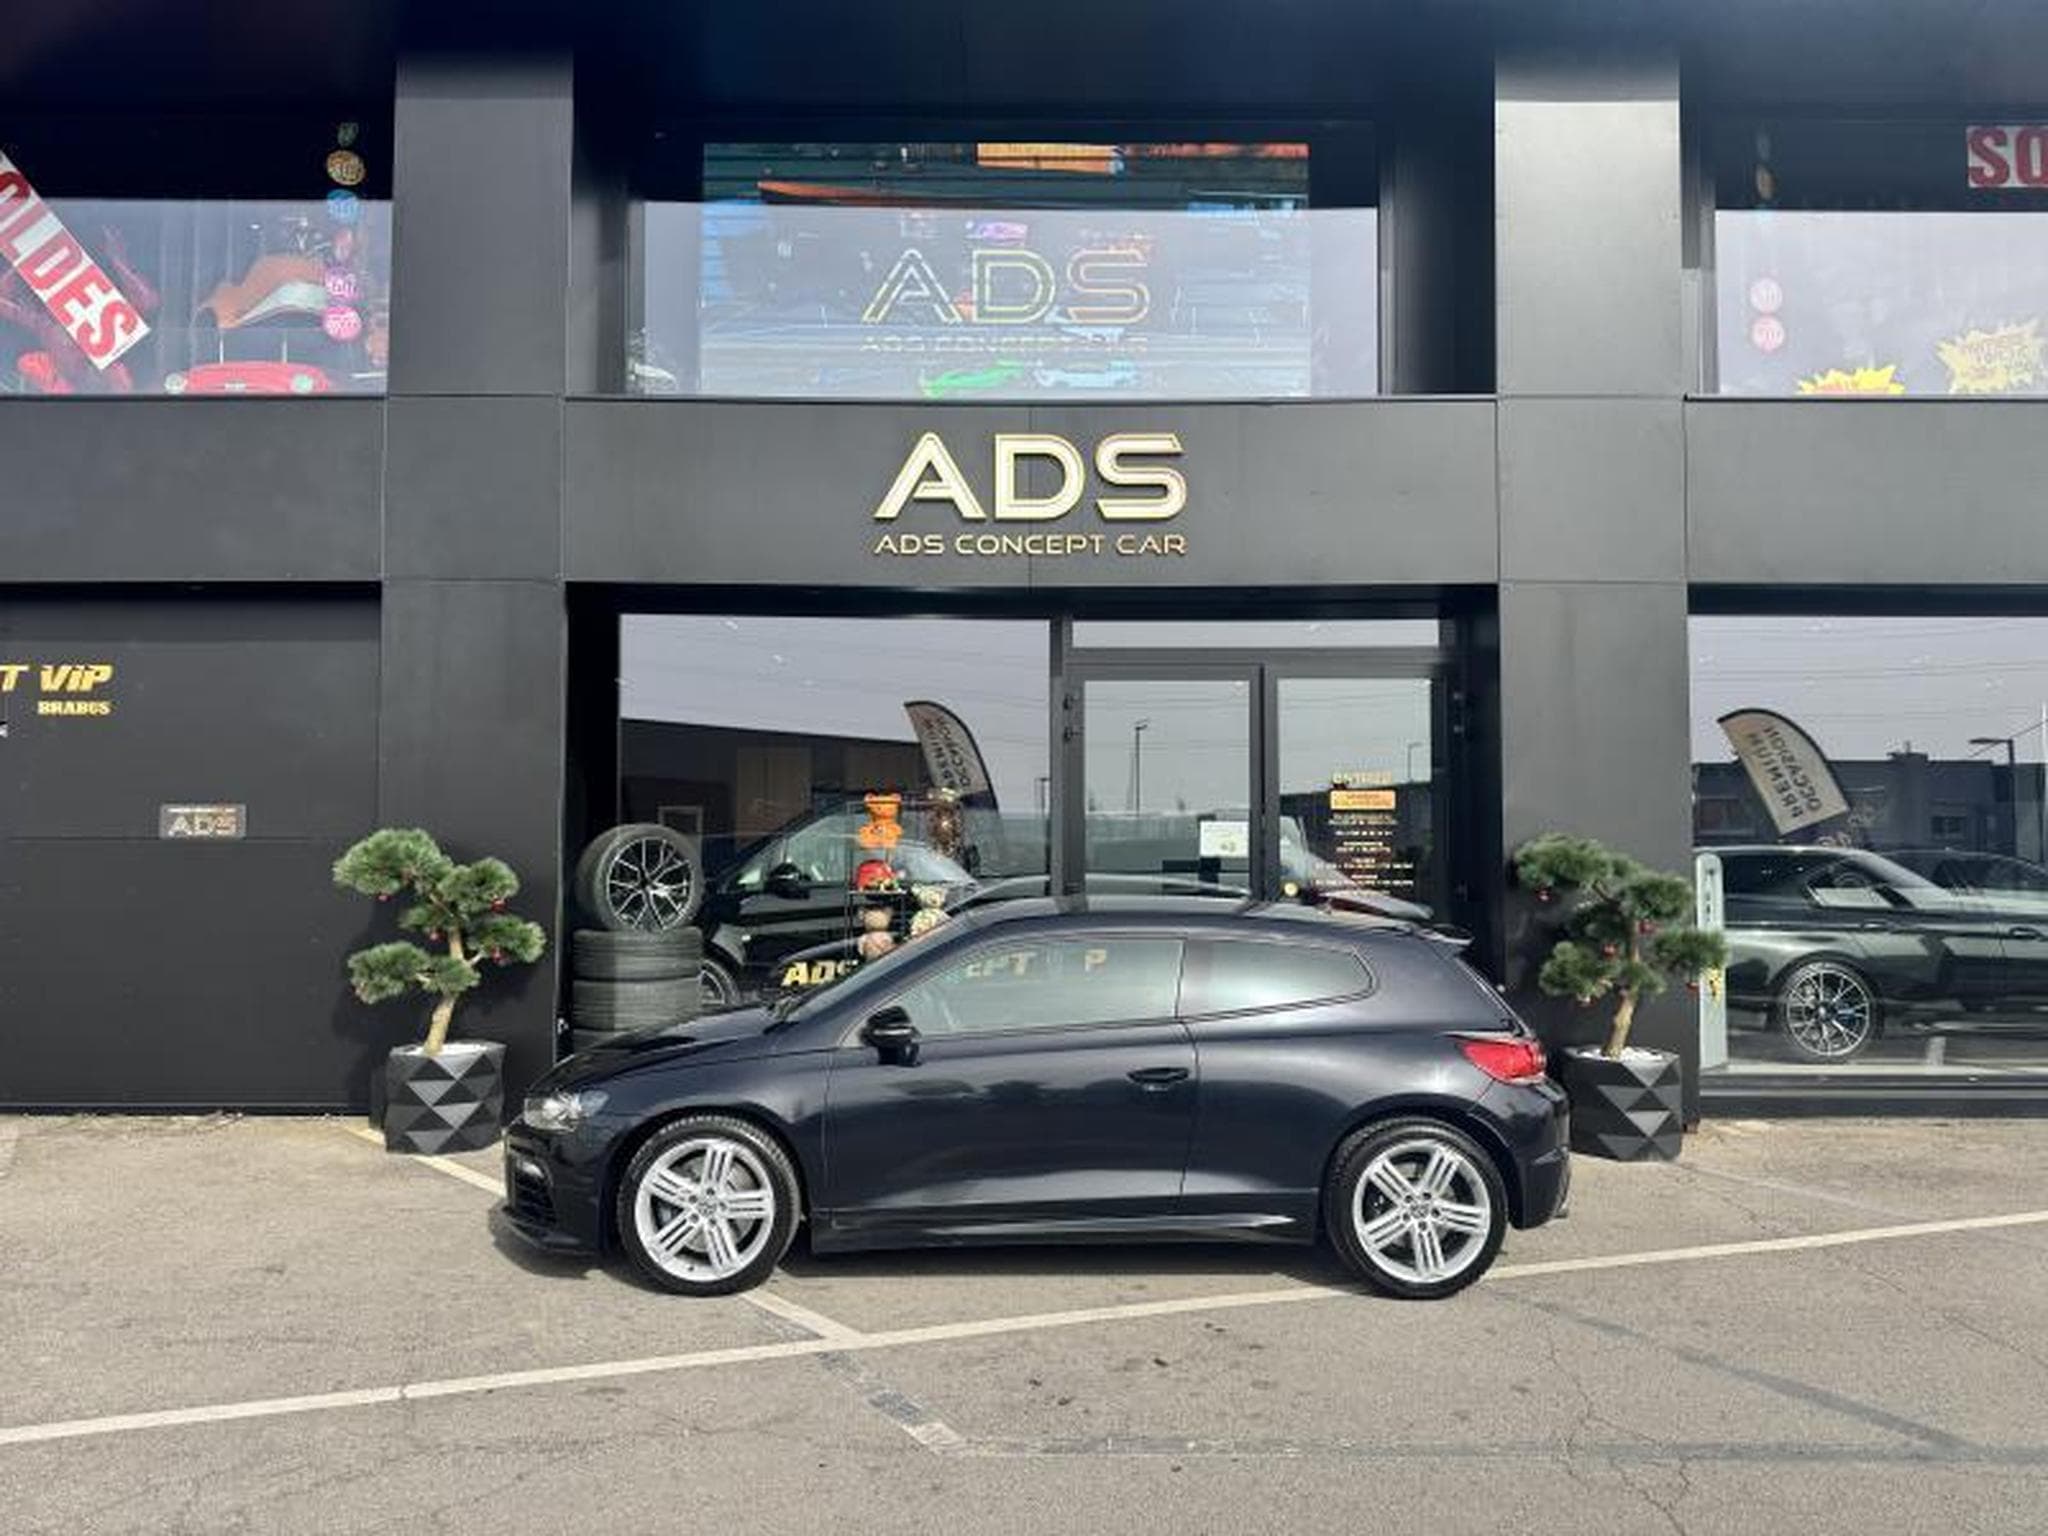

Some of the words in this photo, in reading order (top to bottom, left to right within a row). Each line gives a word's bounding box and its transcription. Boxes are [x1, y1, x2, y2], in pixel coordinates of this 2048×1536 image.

[861, 248, 1152, 324] ADS
[873, 431, 1188, 520] ADS
[874, 534, 945, 555] ADS
[954, 534, 1106, 555] CONCEPT
[1116, 534, 1187, 556] CAR
[37, 701, 112, 716] BRABUS
